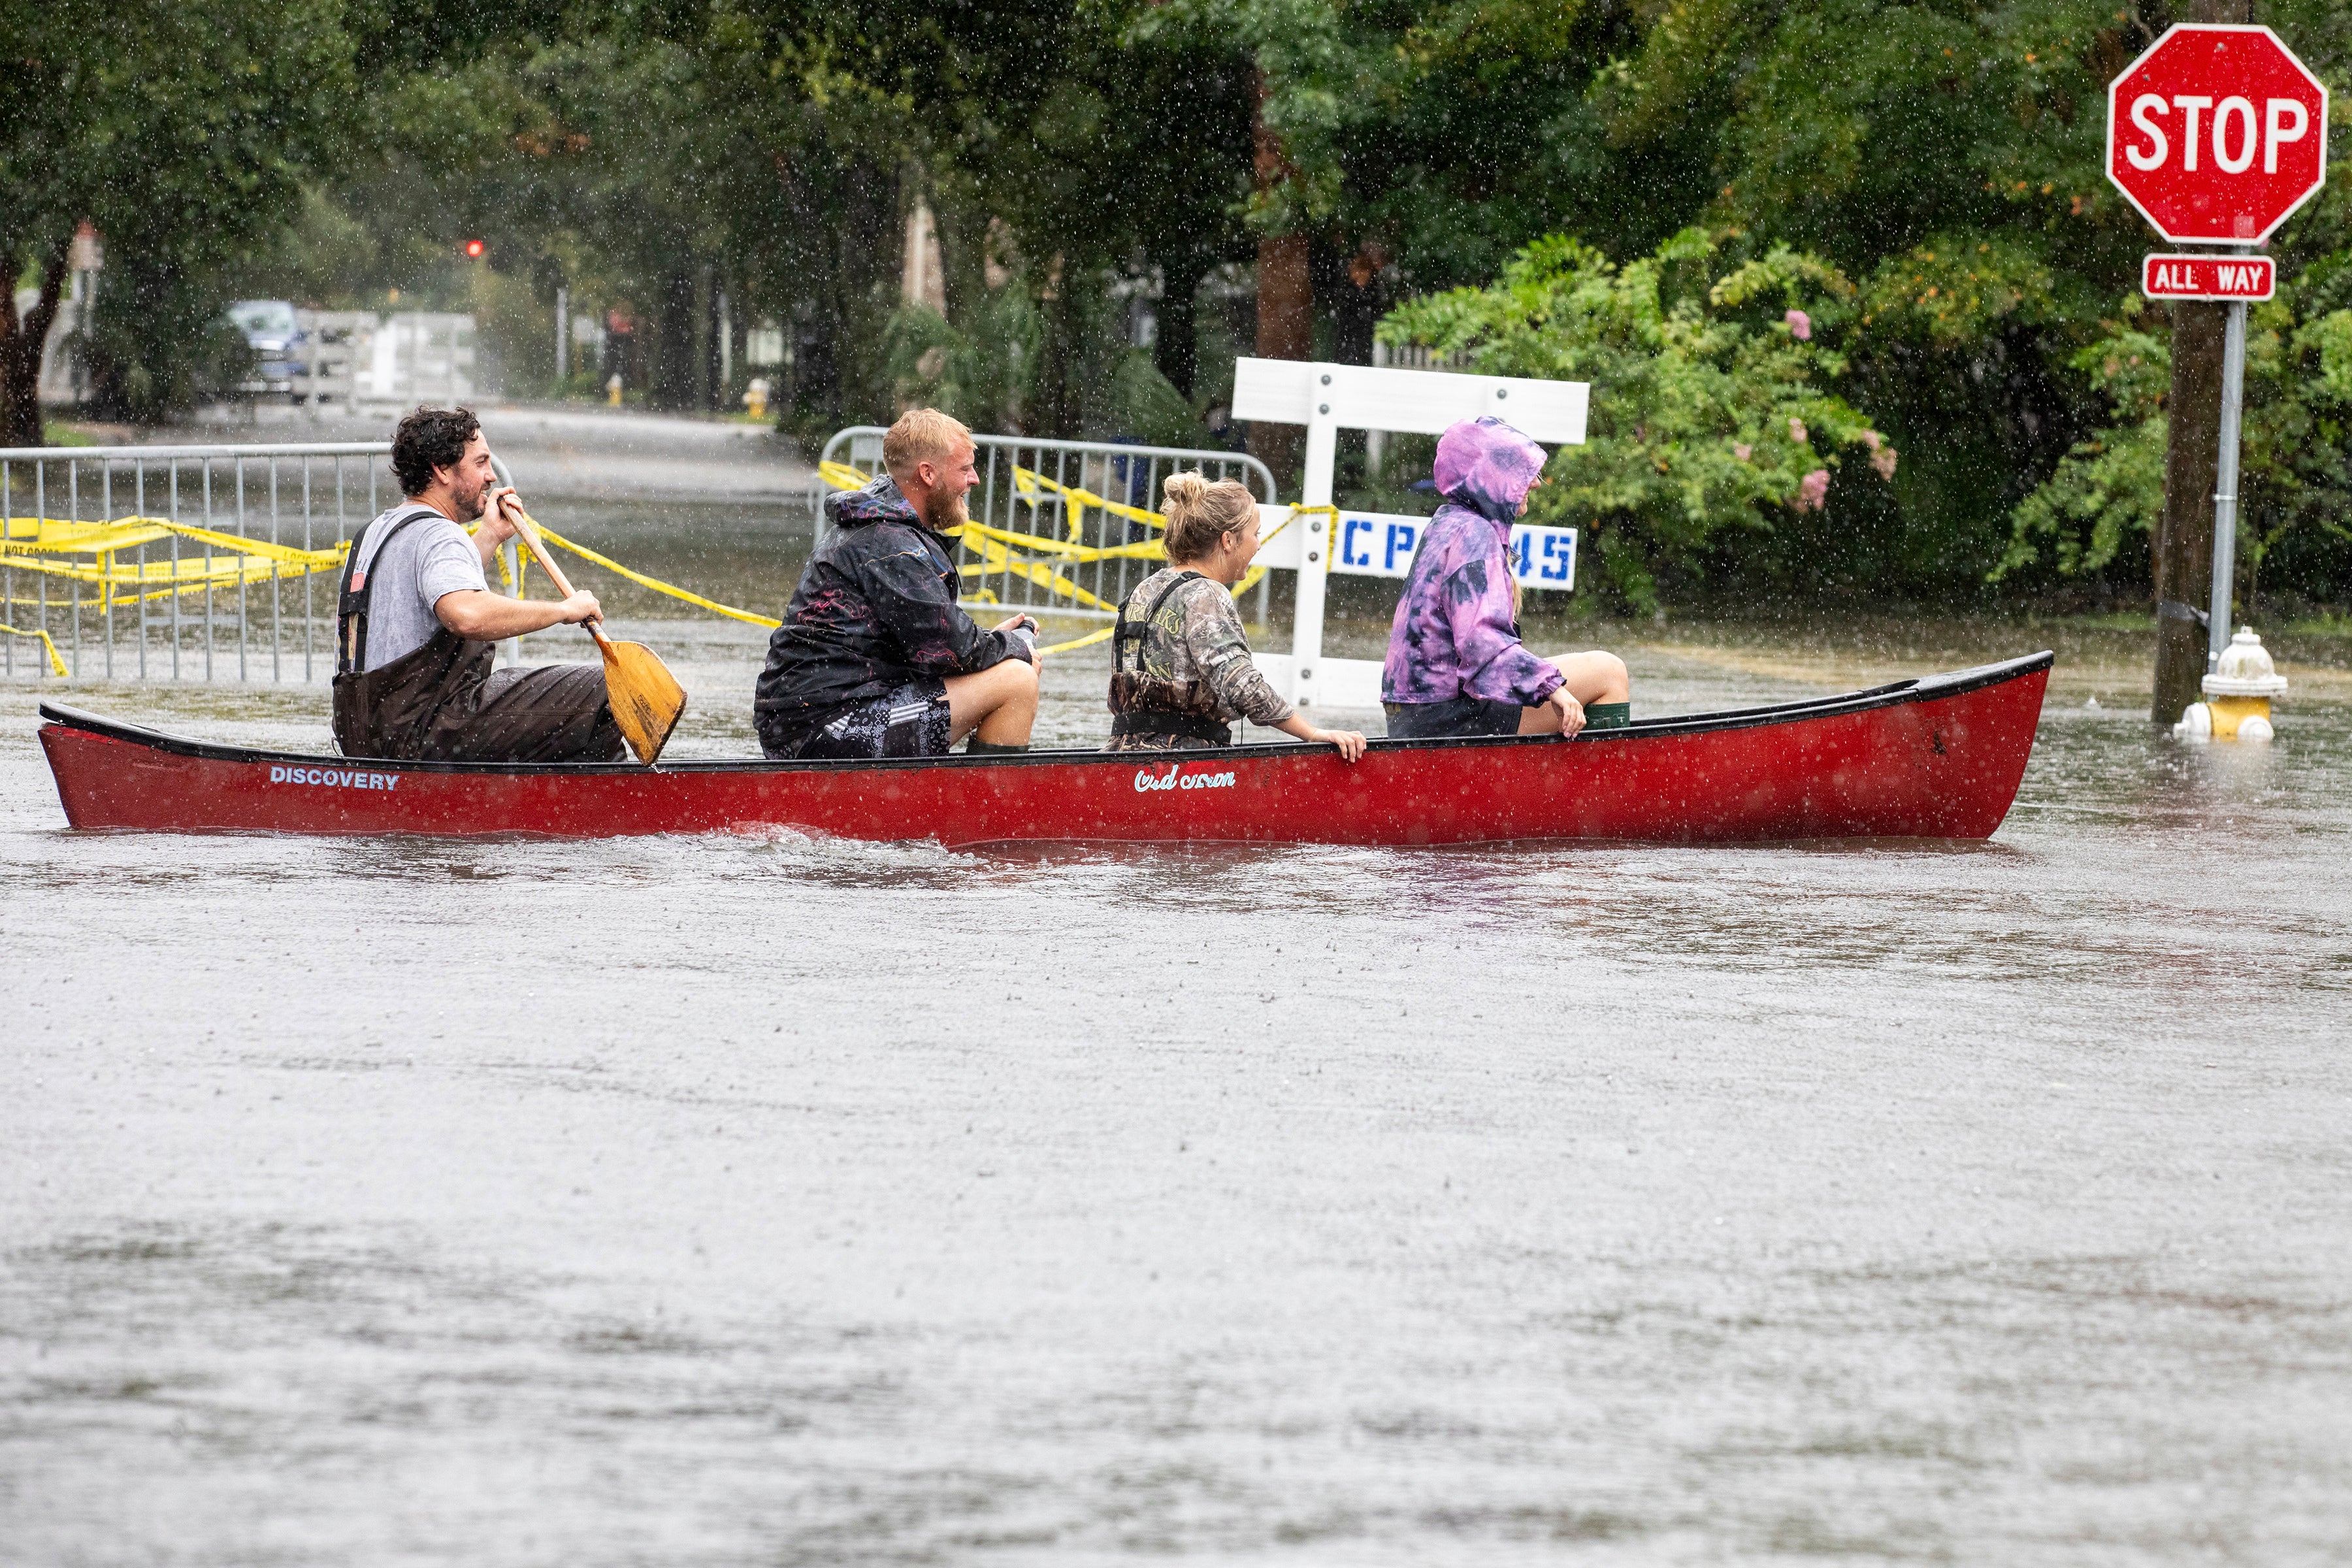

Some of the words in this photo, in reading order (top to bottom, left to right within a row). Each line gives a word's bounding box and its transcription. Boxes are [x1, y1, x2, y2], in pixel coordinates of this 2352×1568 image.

[2125, 93, 2309, 174] STOP
[2155, 264, 2199, 290] ALL
[2217, 265, 2264, 291] WAY
[270, 766, 400, 791] DISCOVERY
